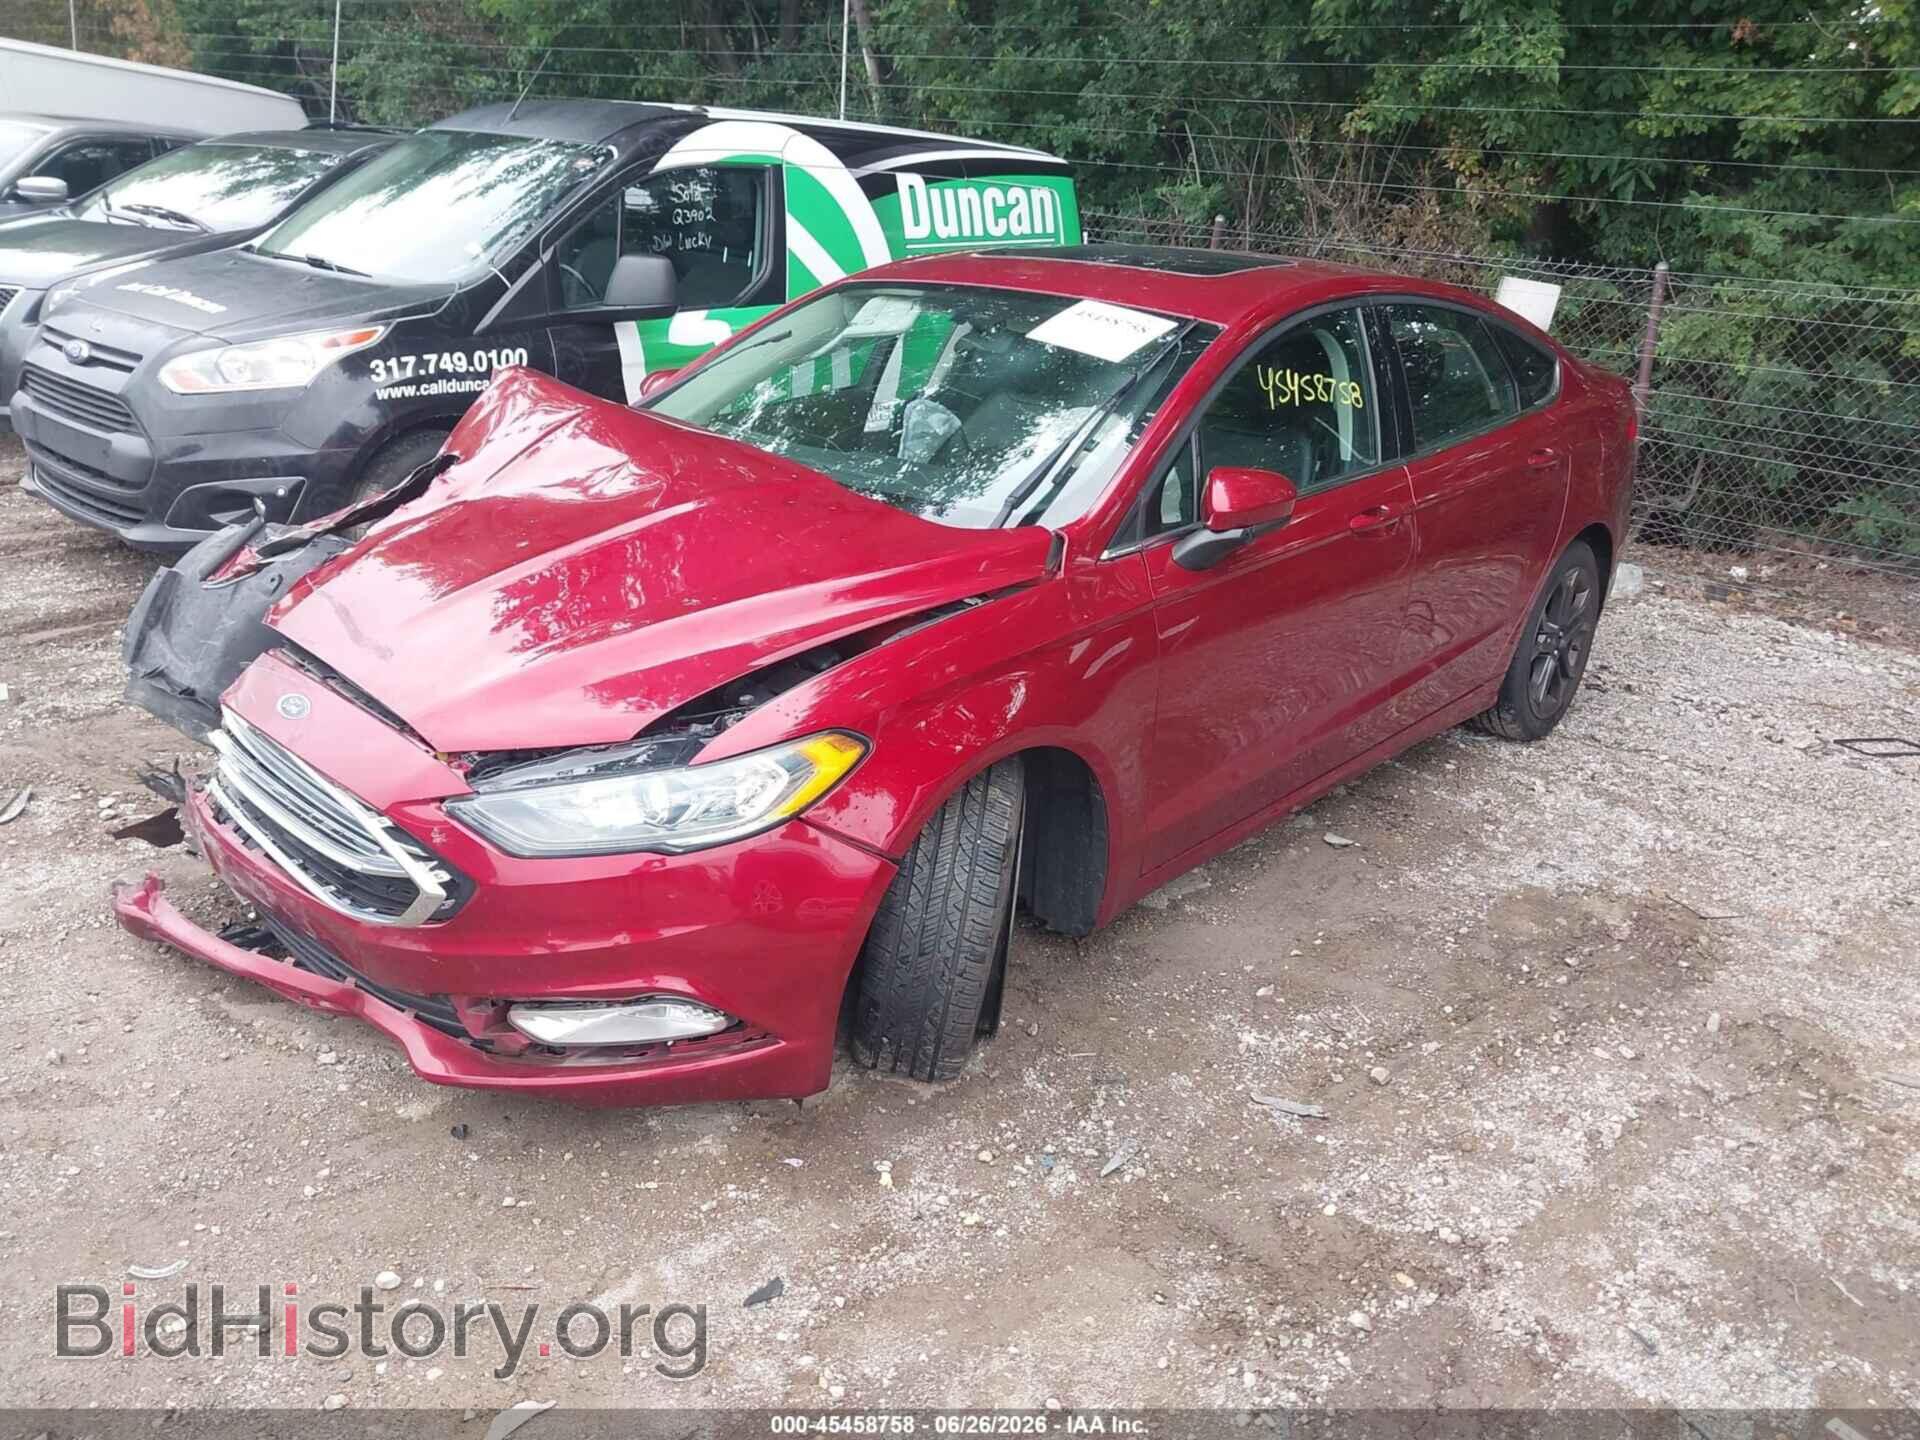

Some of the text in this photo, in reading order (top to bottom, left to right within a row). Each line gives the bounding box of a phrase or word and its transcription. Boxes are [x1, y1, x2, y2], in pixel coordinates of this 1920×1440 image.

[672, 208, 717, 225] Q3902
[896, 172, 1056, 240] Duncan
[369, 347, 528, 382] 317.749.0100
[1257, 364, 1363, 411] 45458758
